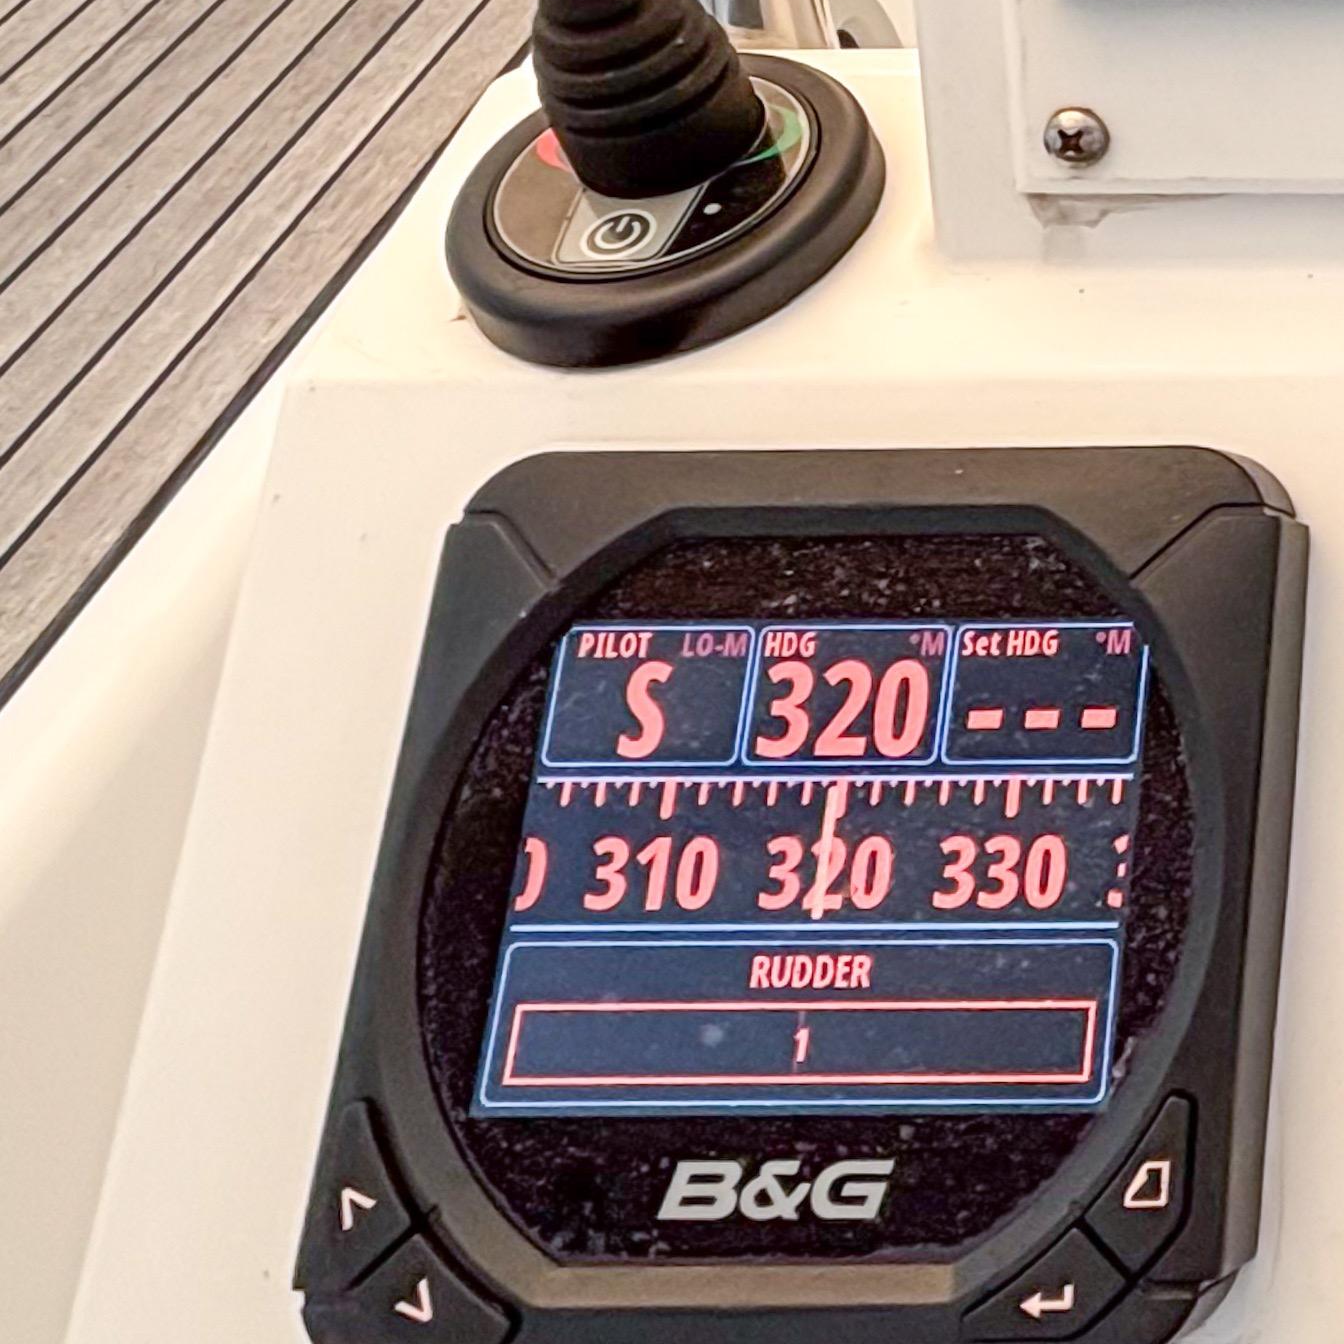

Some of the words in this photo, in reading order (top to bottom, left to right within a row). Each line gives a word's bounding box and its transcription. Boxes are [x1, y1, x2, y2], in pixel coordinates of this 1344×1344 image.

[577, 631, 652, 659] PILOT
[681, 632, 746, 658] LO-M
[764, 631, 817, 657] HDG
[962, 630, 1001, 657] Set
[1006, 630, 1058, 656] HDG
[617, 660, 674, 759] S
[755, 659, 930, 758] 320
[583, 835, 720, 912] 310
[757, 835, 894, 912] 320
[932, 834, 1069, 910] 330
[749, 954, 872, 990] RUDDER
[657, 1158, 895, 1221] B&G
